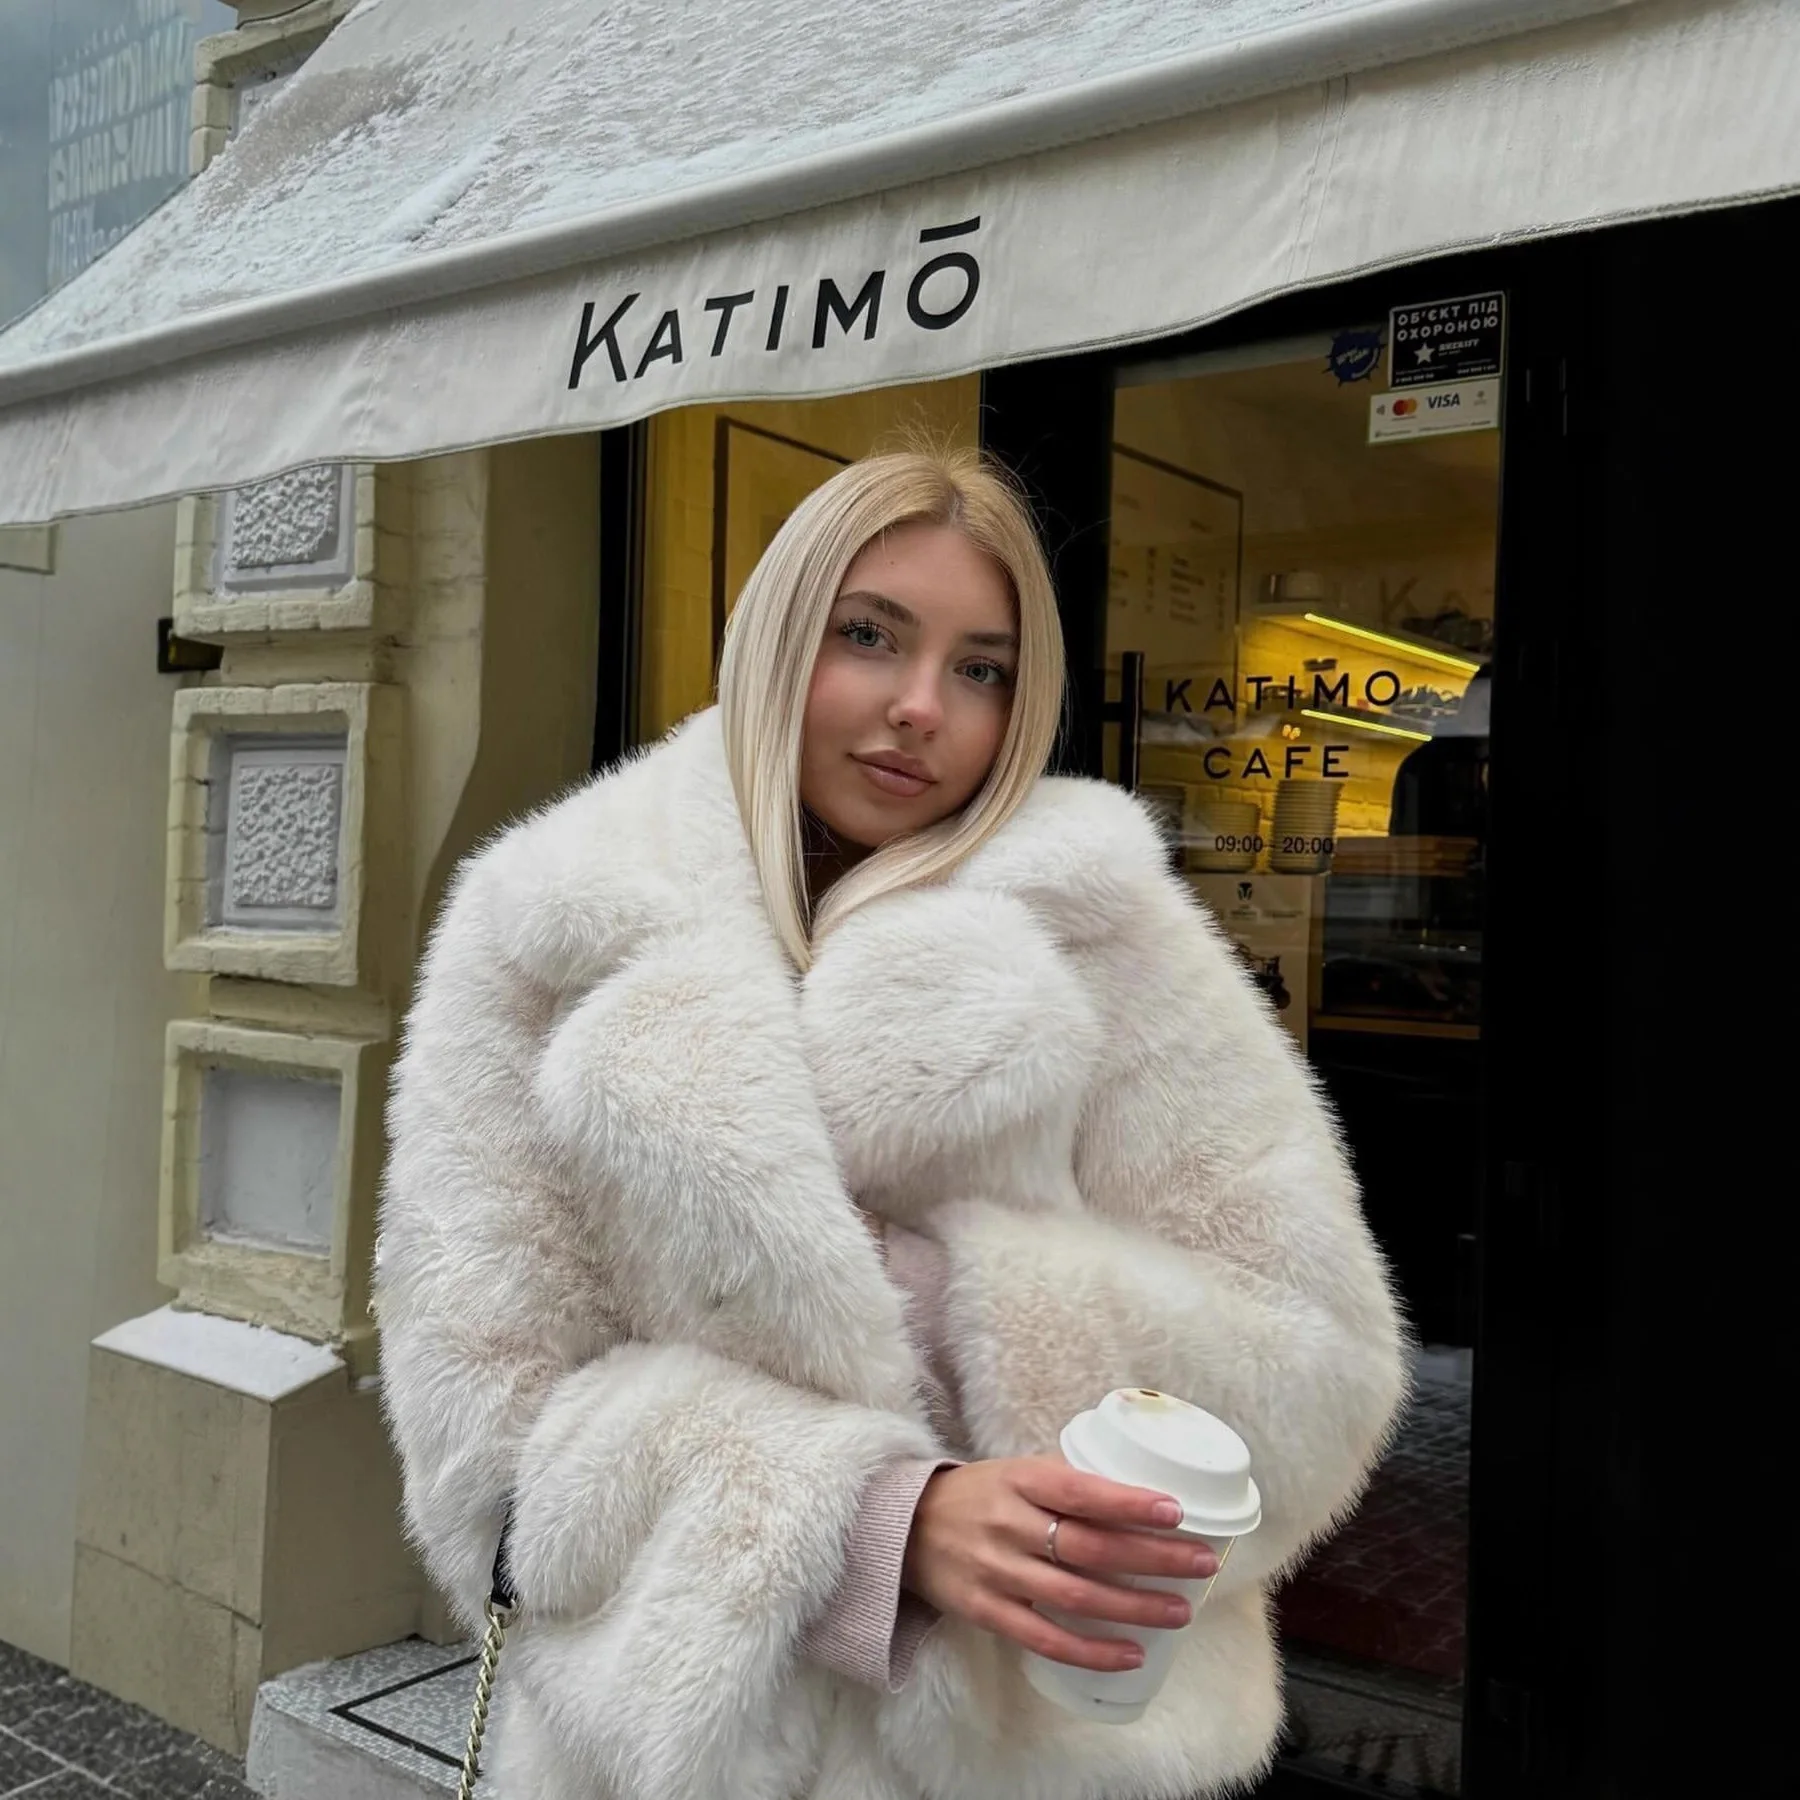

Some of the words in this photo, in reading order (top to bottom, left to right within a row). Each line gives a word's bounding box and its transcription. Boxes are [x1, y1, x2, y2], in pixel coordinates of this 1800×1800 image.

[568, 216, 980, 389] KATIMŌ
[1397, 304, 1461, 326] ОБ'ЄКТ
[1468, 299, 1499, 315] ПІД
[1396, 315, 1499, 342] ОХОРОНОЮ
[1427, 393, 1461, 409] VISA
[1165, 670, 1401, 713] KATIMO
[1203, 745, 1350, 779] CAFE
[1215, 835, 1264, 853] 09:00
[1282, 836, 1334, 854] 20:00
